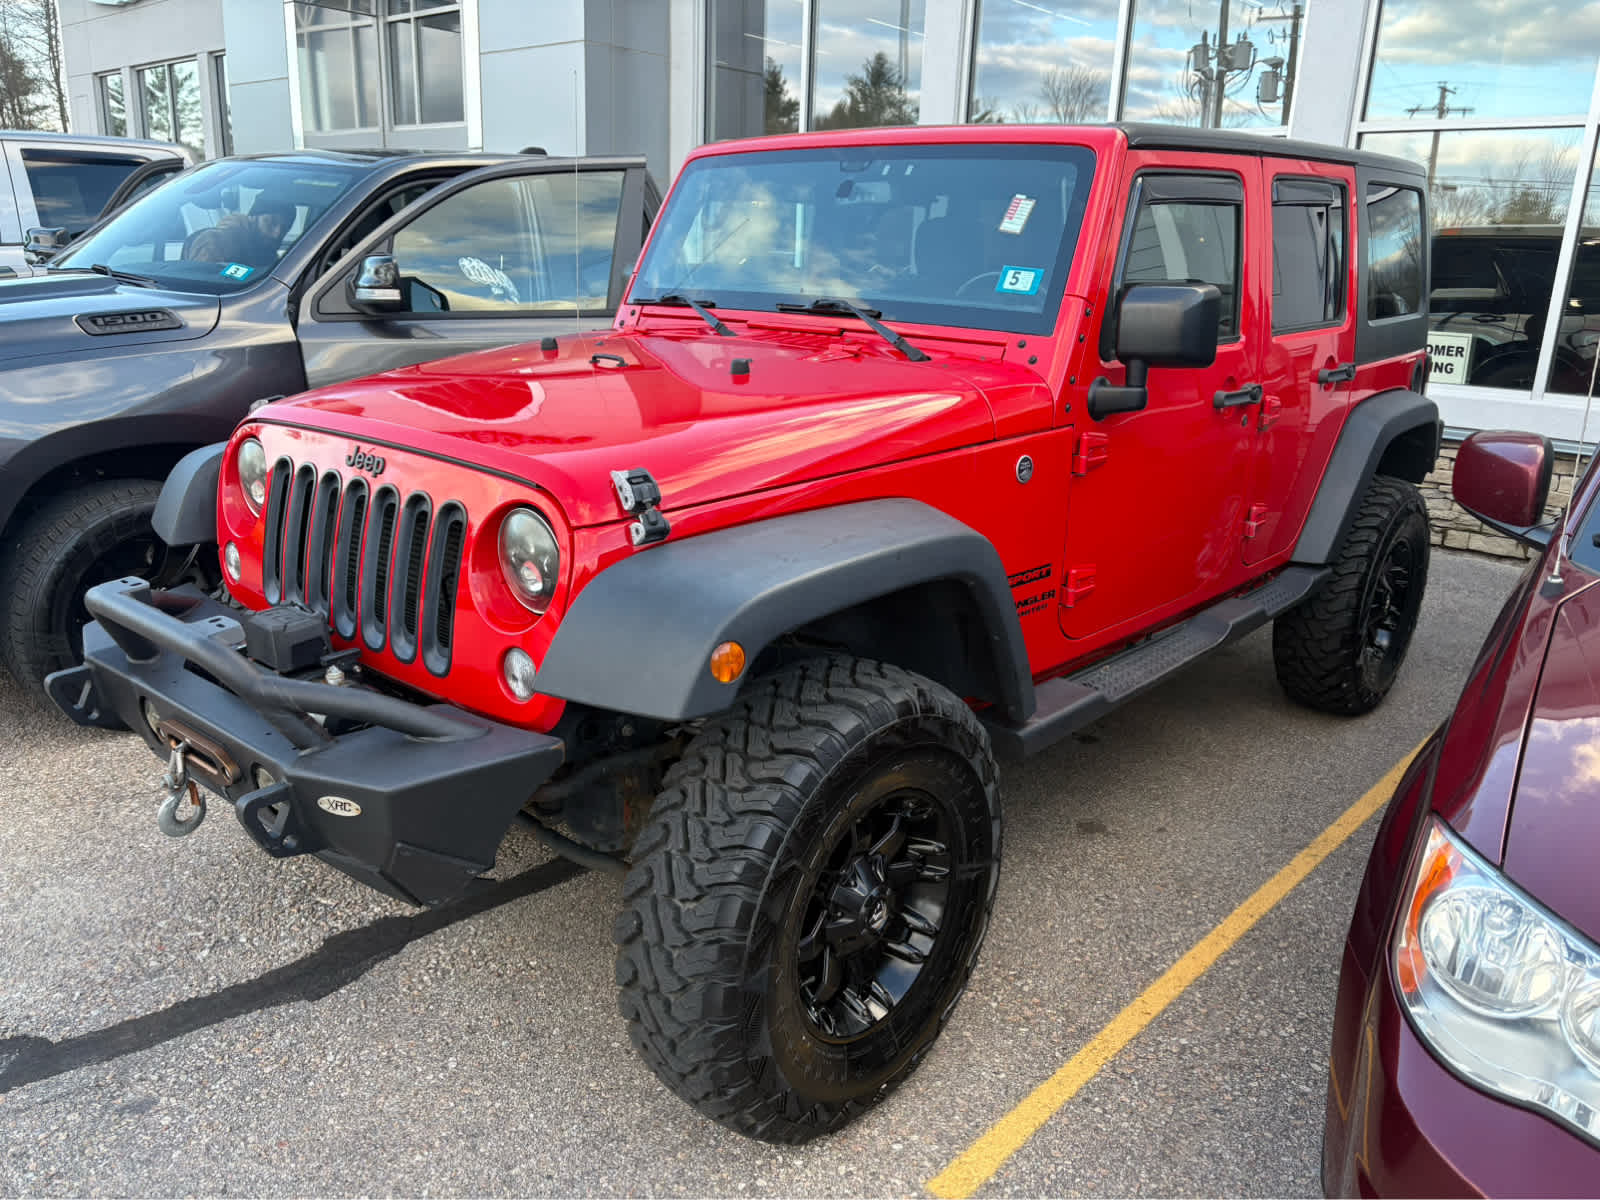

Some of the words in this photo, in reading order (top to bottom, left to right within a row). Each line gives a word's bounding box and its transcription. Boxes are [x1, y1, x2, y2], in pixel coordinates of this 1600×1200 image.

[1009, 271, 1022, 286] 5
[93, 311, 163, 326] 1500
[1433, 361, 1455, 374] NG
[345, 446, 385, 478] Jeep
[1015, 590, 1056, 608] NGLER
[327, 798, 352, 812] XRC
